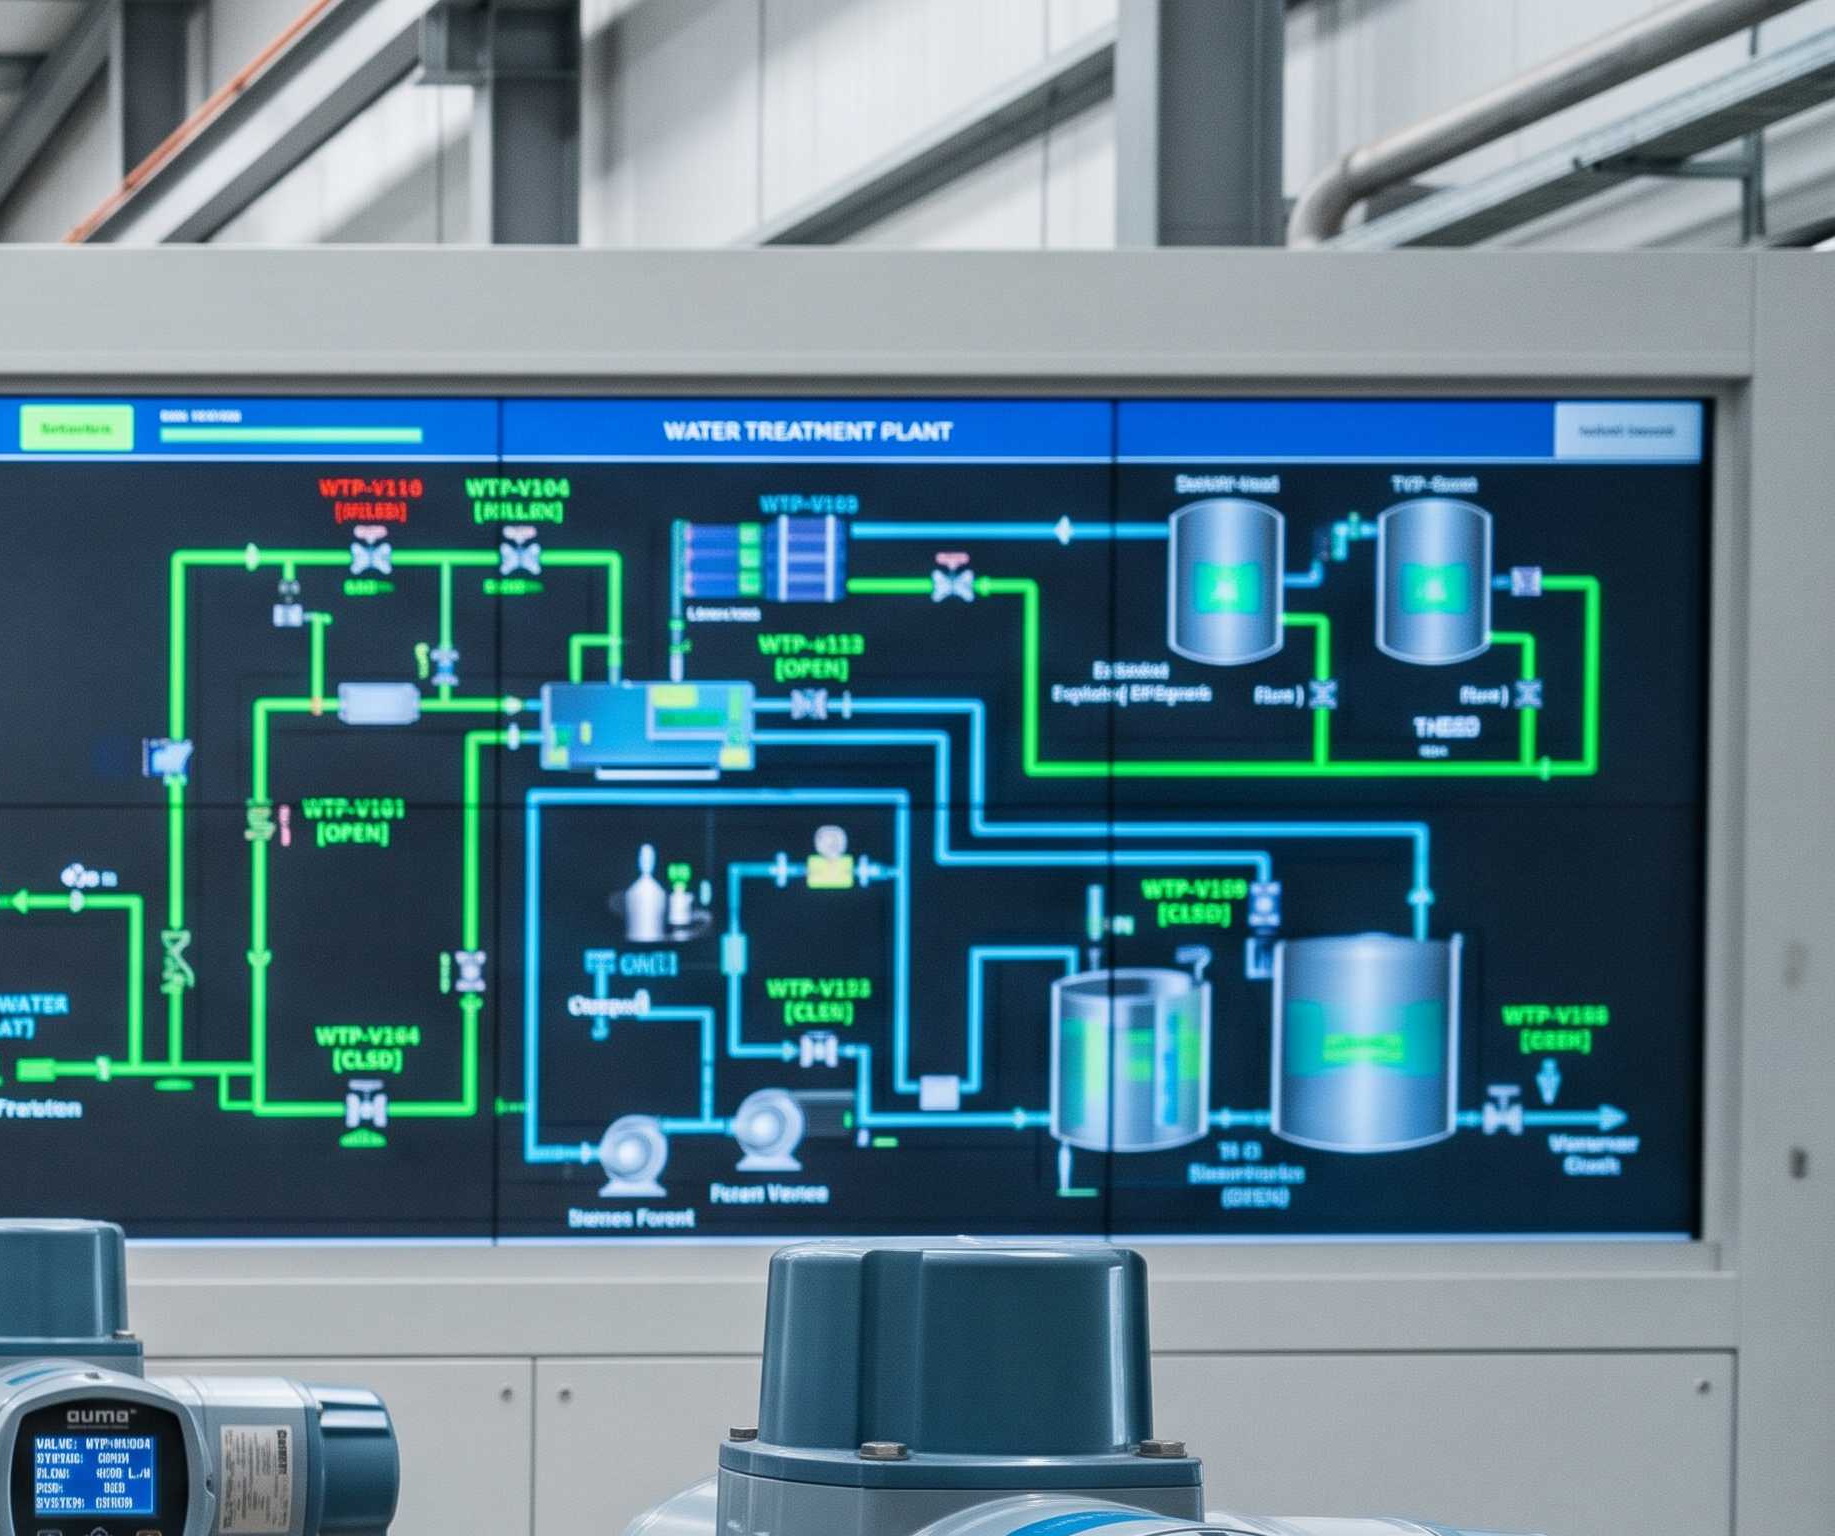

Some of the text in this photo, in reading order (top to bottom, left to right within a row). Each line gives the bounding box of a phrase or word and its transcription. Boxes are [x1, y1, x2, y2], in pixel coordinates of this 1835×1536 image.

[664, 421, 953, 441] WATER TREATMENT PLANT
[316, 821, 390, 848] [OPEN]
